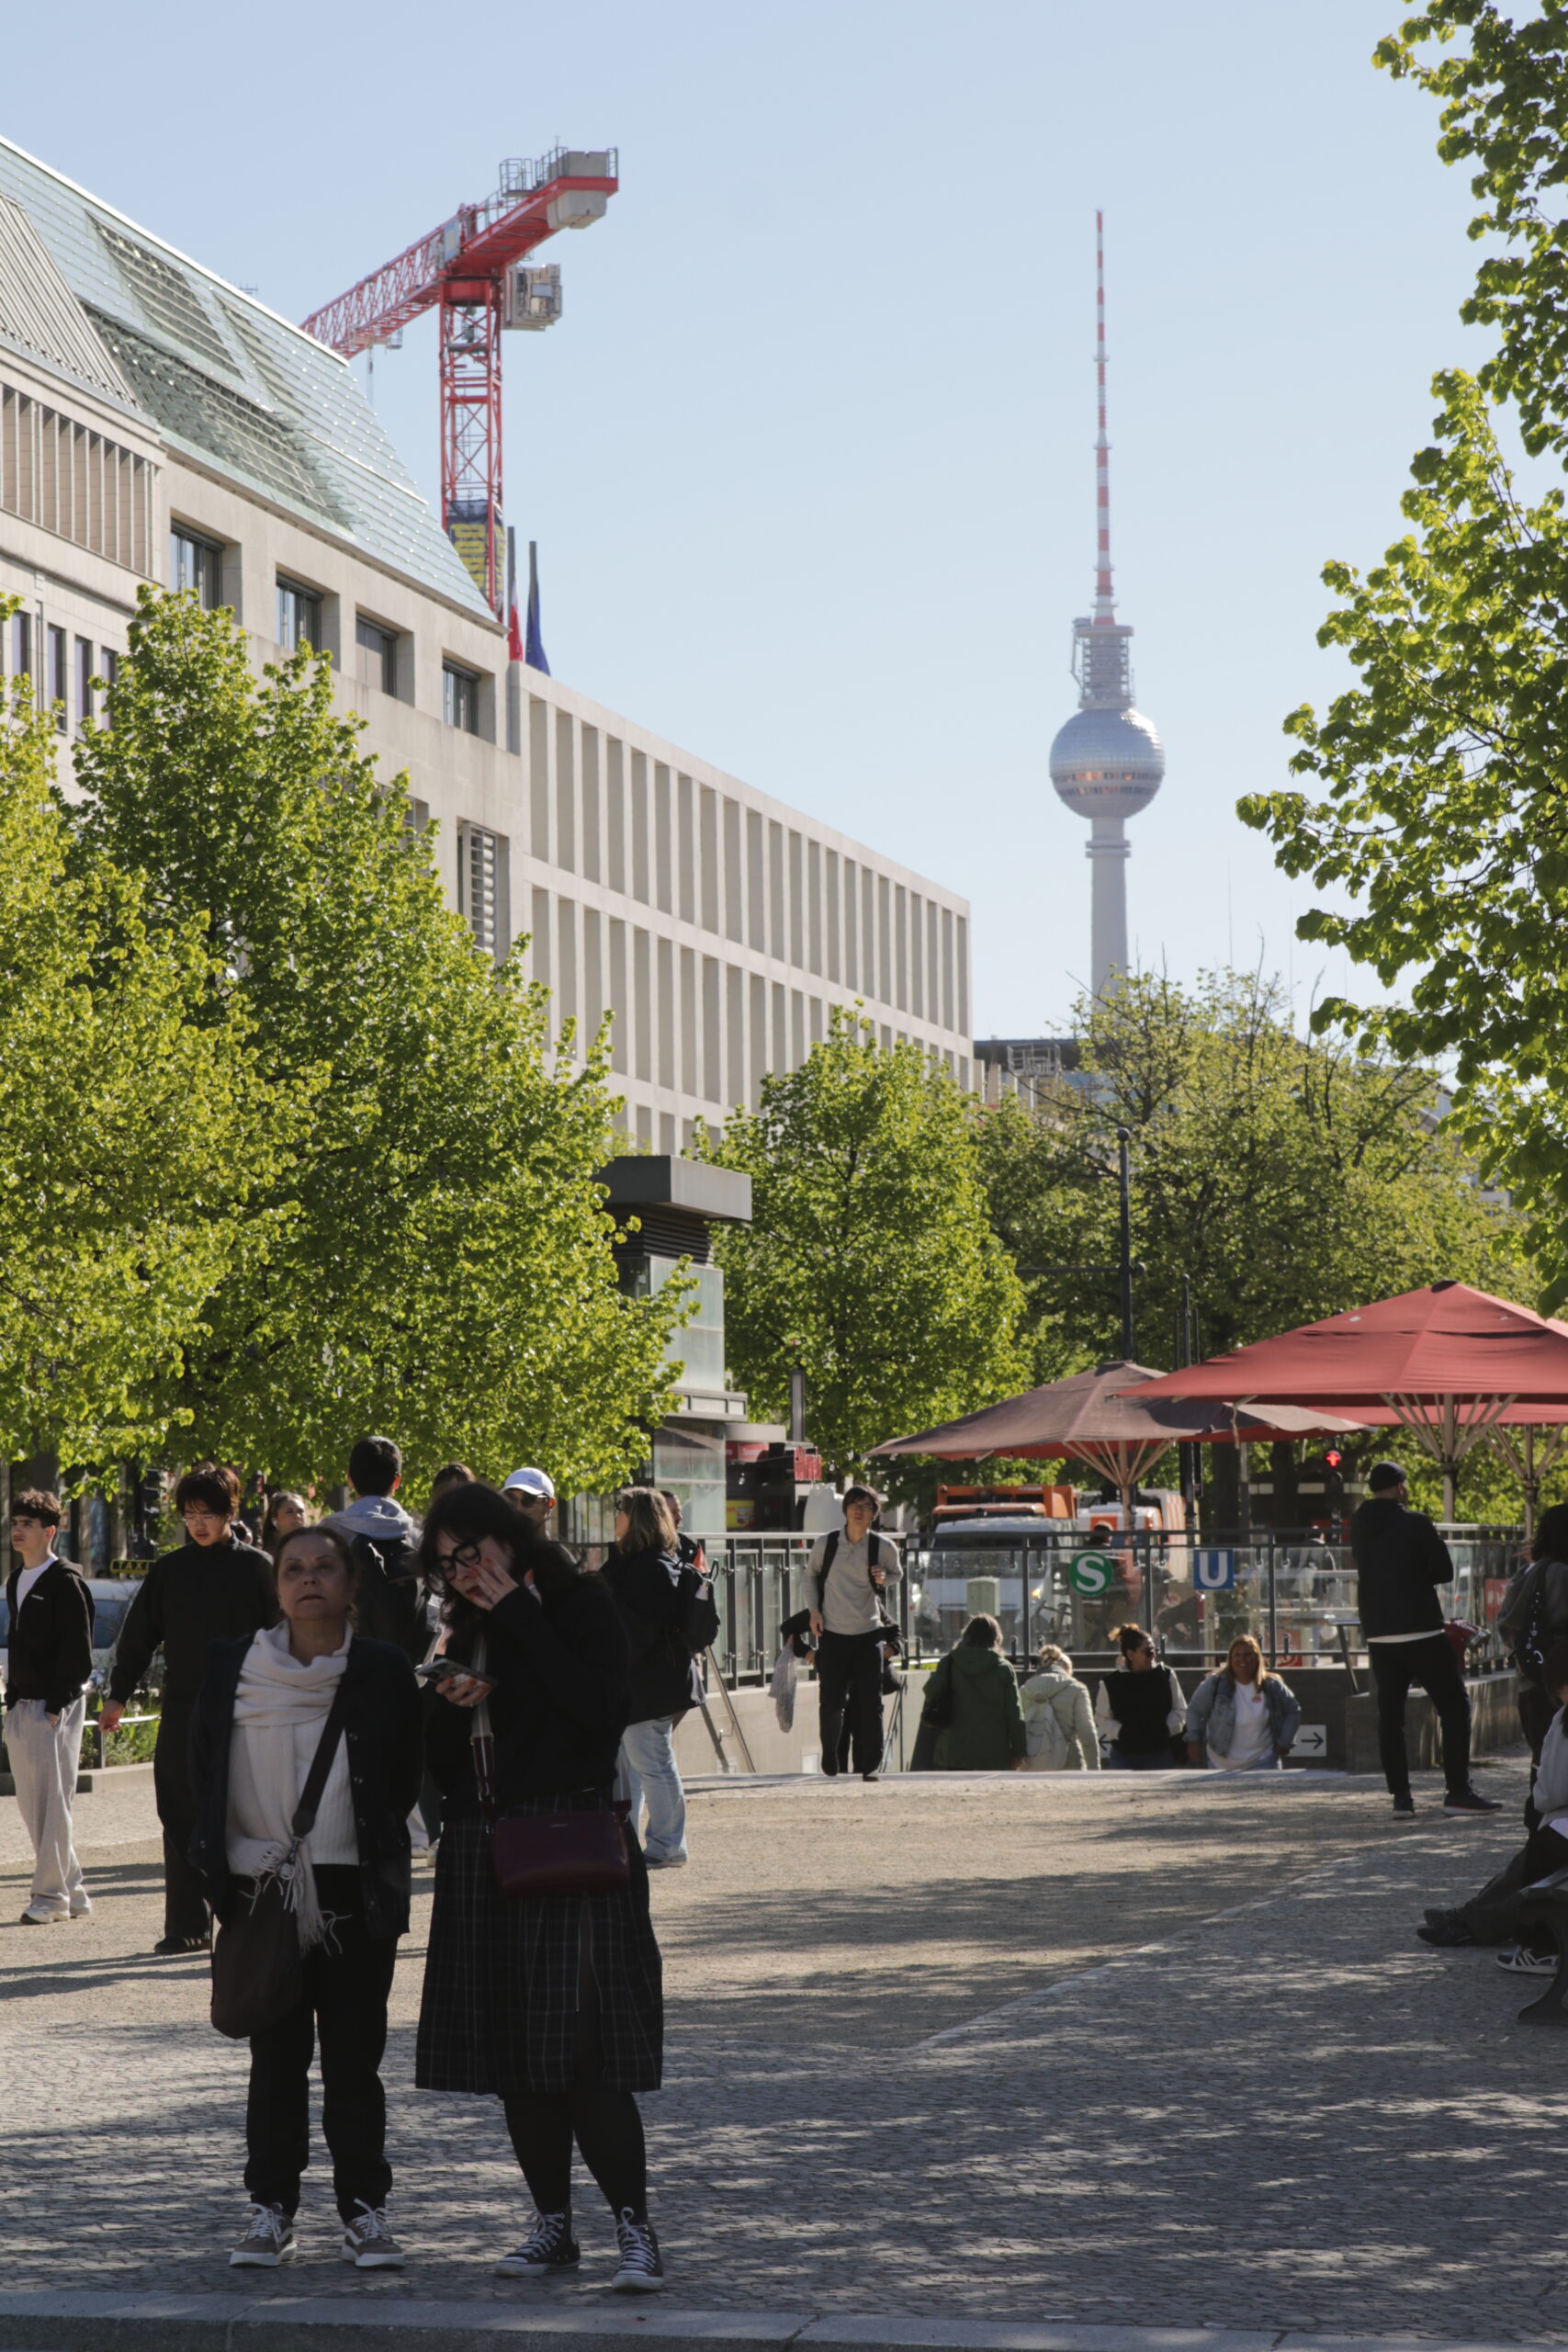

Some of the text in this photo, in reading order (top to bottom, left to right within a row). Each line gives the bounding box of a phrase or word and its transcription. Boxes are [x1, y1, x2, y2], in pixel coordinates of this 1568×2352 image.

[118, 1561, 149, 1570] TAXI
[1076, 1555, 1106, 1592] S
[1199, 1551, 1228, 1588] U
